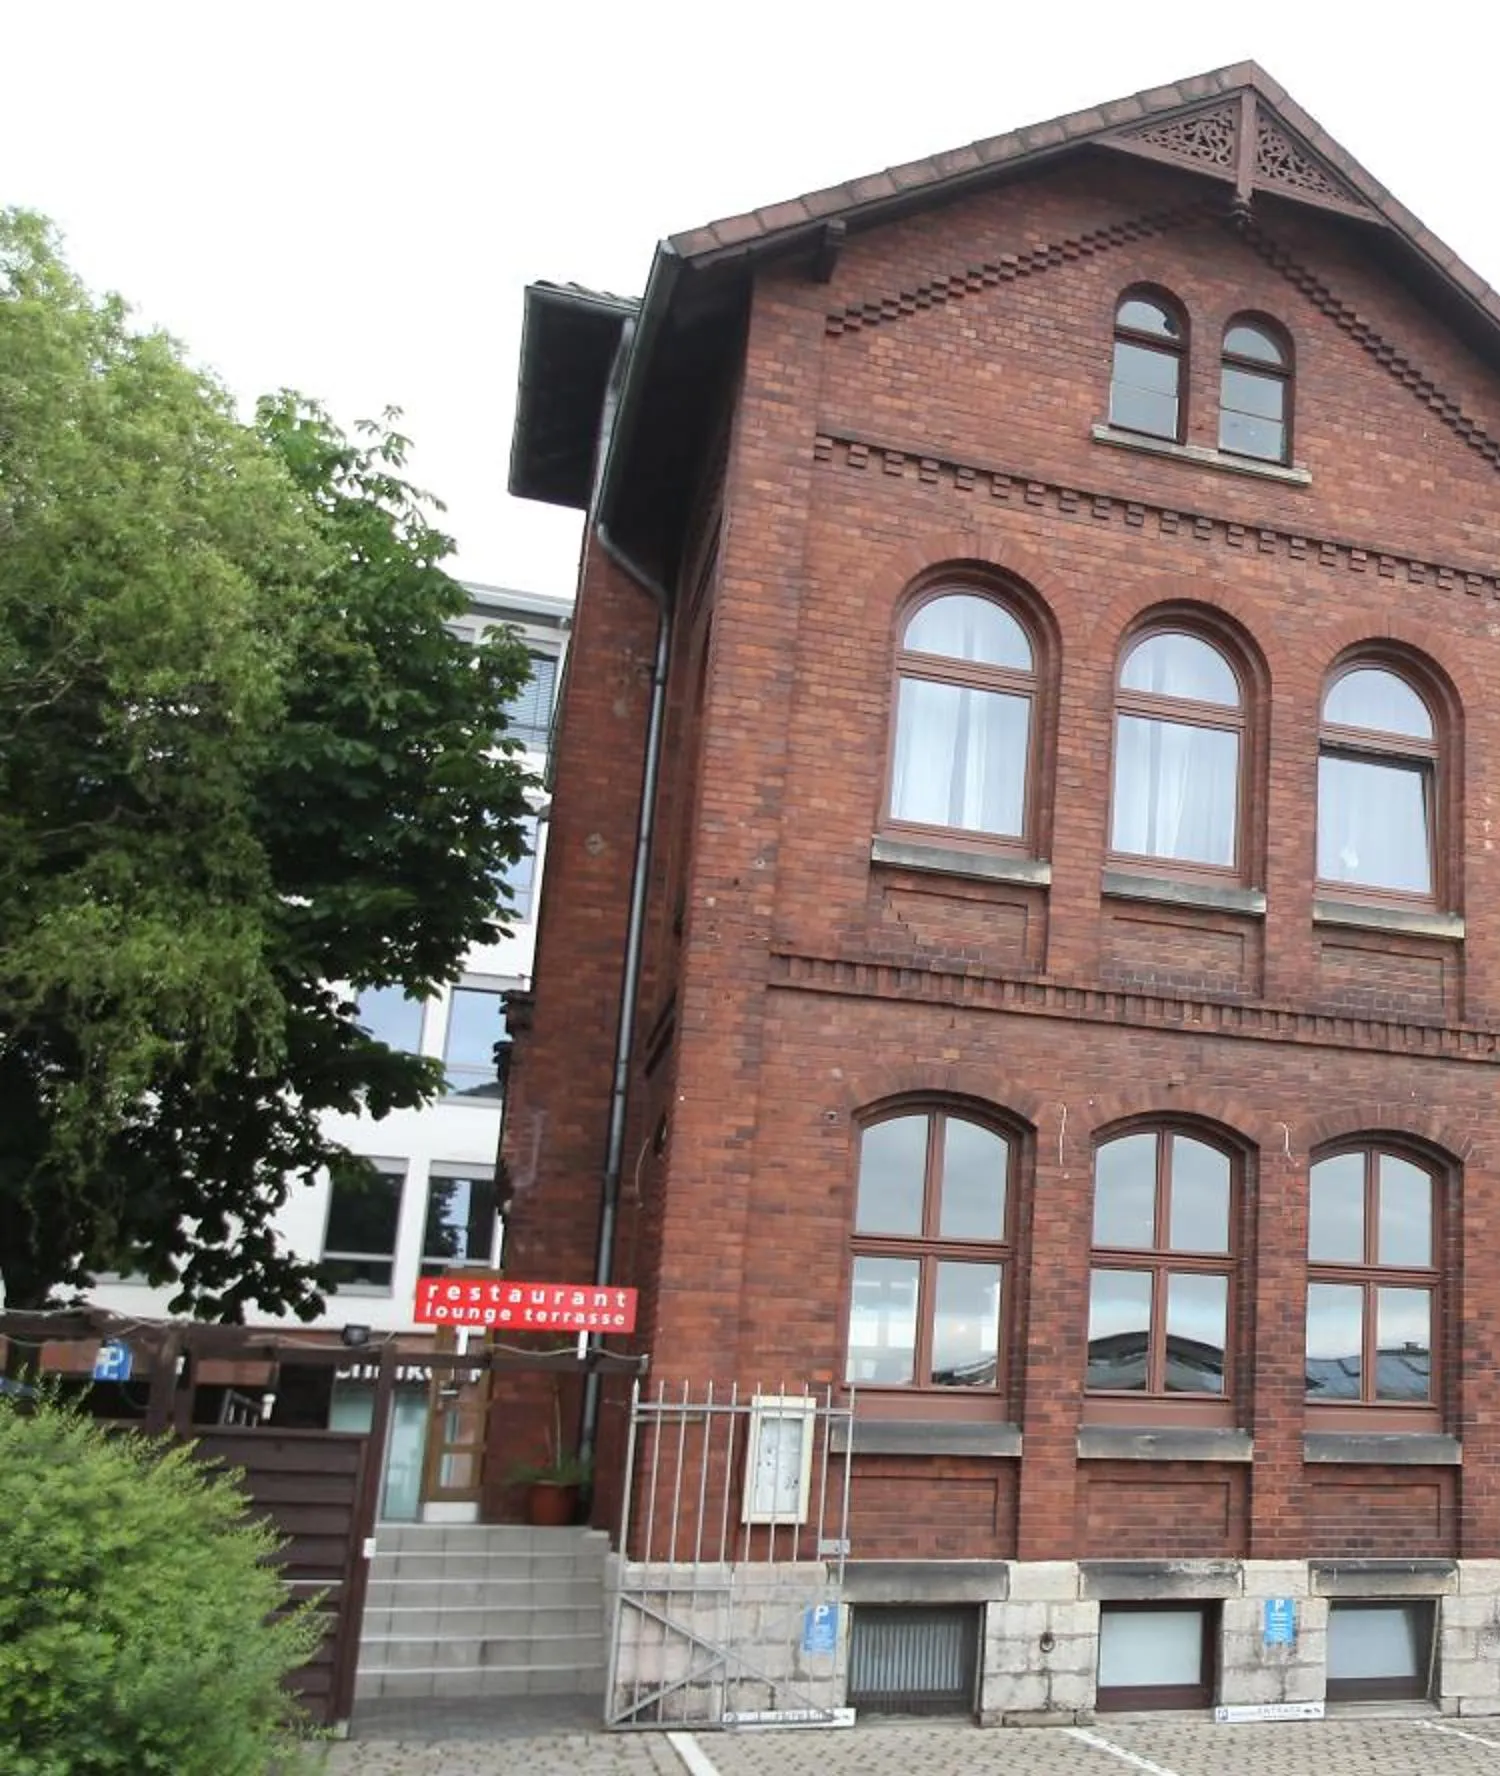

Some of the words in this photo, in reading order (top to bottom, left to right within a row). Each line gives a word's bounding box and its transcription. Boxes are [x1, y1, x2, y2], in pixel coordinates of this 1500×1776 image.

[428, 1283, 627, 1308] restaurant
[425, 1302, 512, 1323] lounge
[524, 1306, 625, 1326] terrasse
[815, 1605, 829, 1624] P
